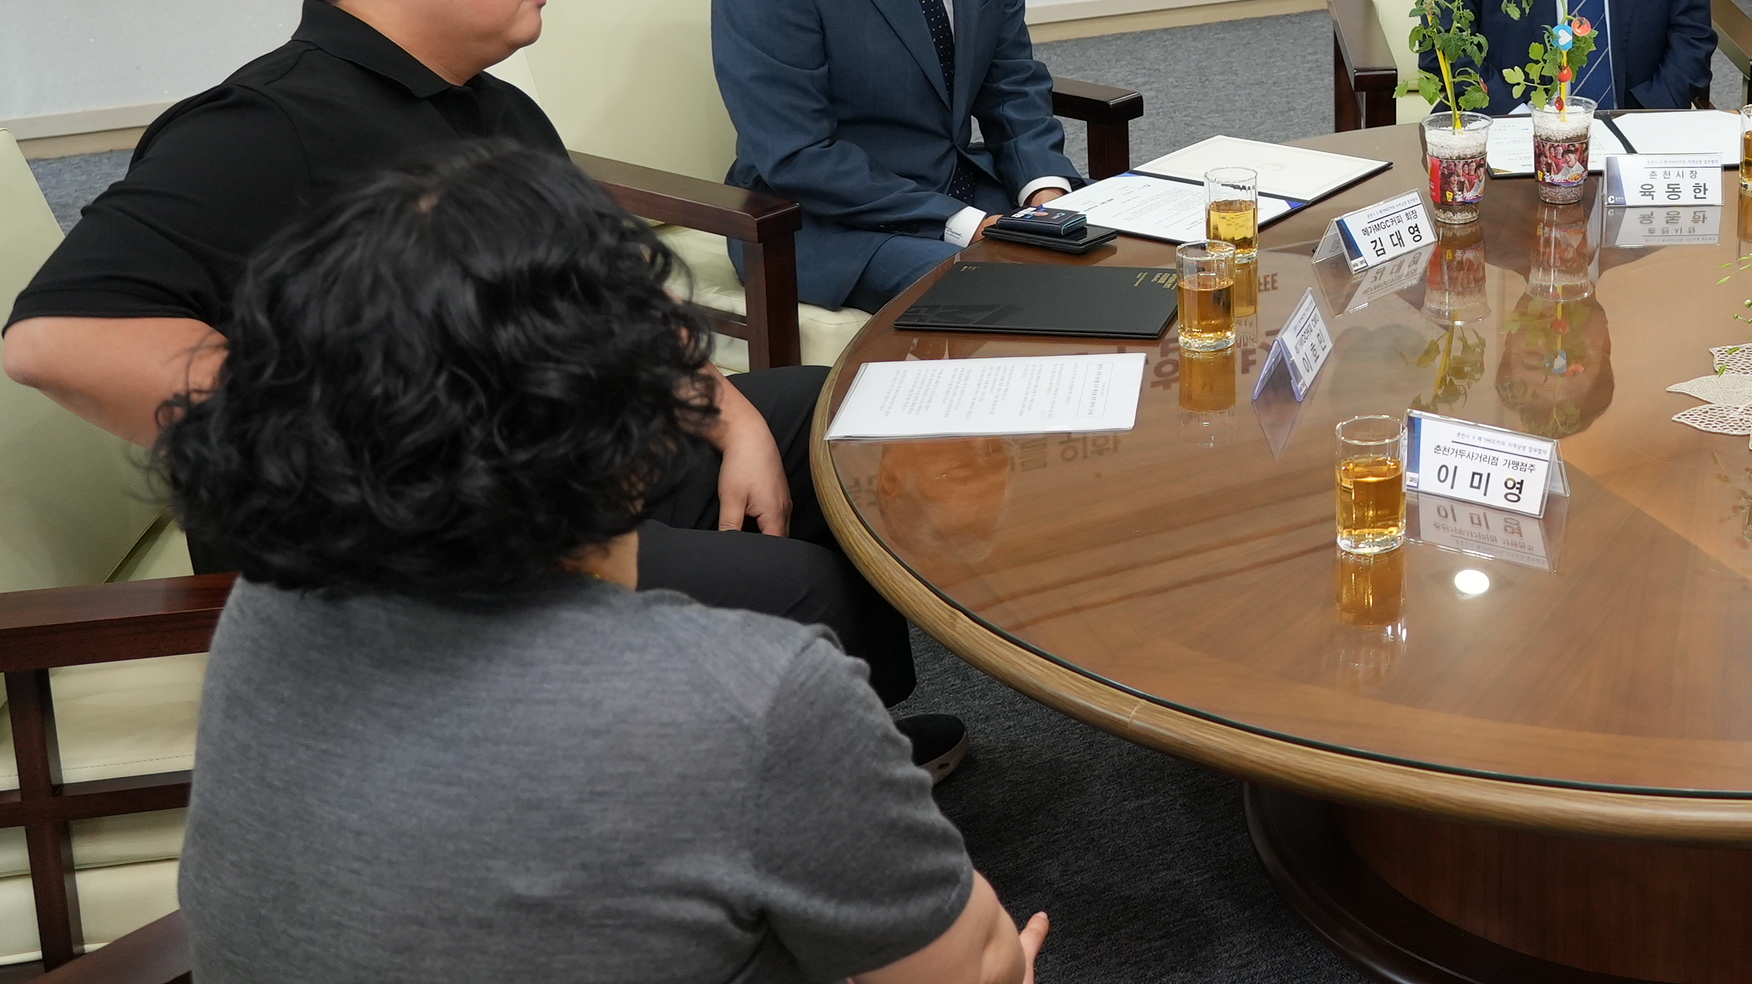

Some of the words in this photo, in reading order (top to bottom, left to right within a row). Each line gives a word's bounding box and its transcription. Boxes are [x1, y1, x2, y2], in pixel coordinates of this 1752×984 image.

[1361, 215, 1404, 237] 메가MGC커피
[1405, 209, 1419, 221] 회장
[1433, 444, 1499, 466] 춘천거두사거리점
[1502, 458, 1537, 475] 가맹점주
